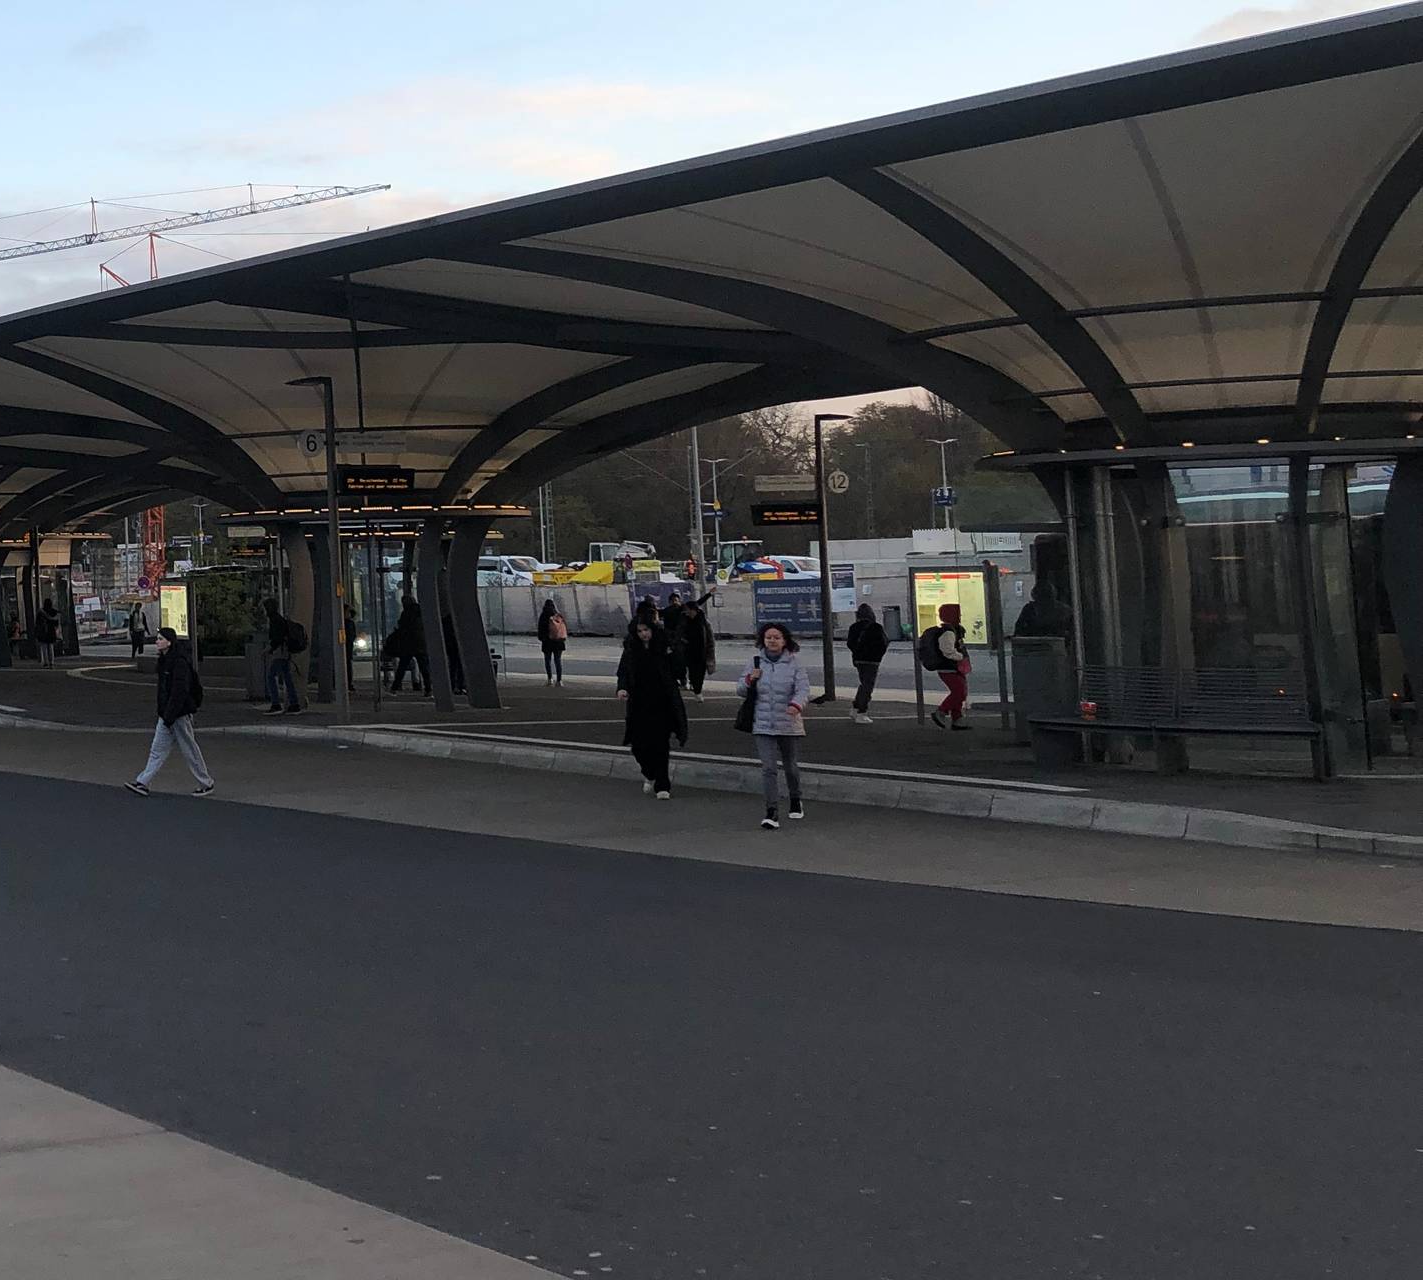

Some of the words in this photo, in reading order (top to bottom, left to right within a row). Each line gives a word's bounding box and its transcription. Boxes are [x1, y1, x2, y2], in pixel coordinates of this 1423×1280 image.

[306, 434, 317, 452] 6
[830, 475, 847, 489] 12
[757, 586, 822, 595] ARBEITSGEMEINSCHA
